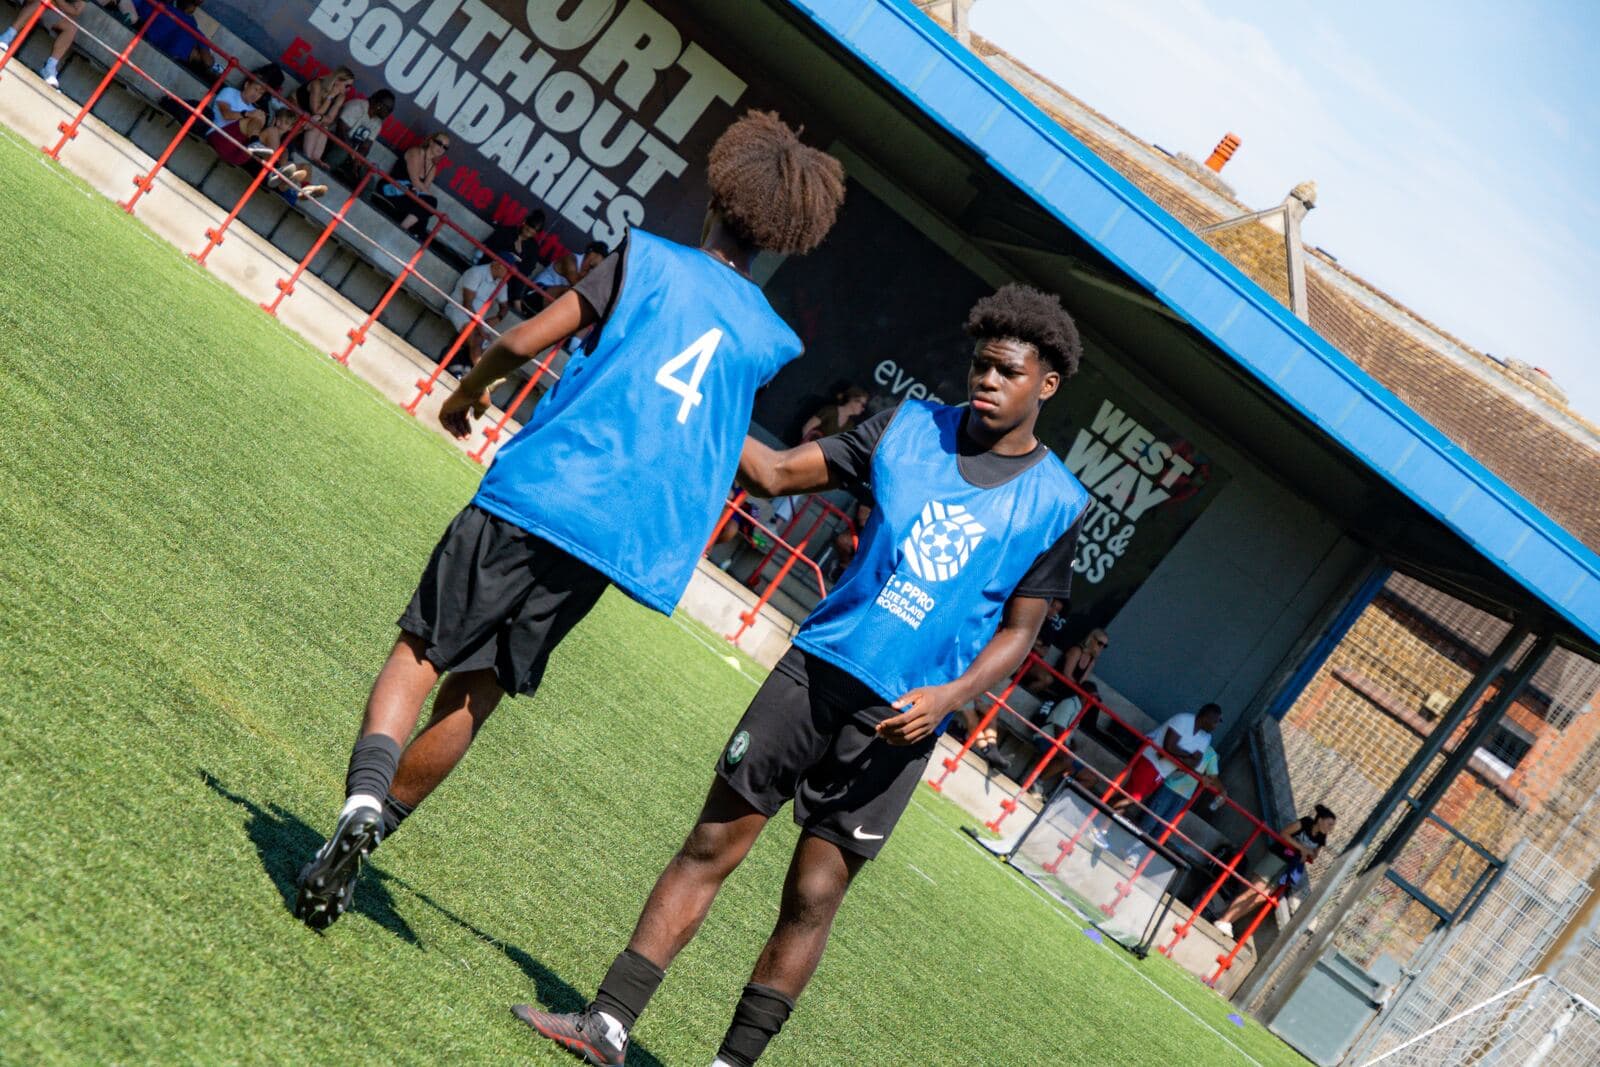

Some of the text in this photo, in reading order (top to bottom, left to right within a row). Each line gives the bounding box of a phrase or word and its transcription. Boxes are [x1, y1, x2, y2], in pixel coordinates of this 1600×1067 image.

[307, 0, 645, 254] BOUNDARIES
[397, 0, 689, 198] ITHOUT
[655, 327, 724, 425] 4
[1064, 427, 1172, 522] WAY
[1090, 398, 1195, 489] WEST
